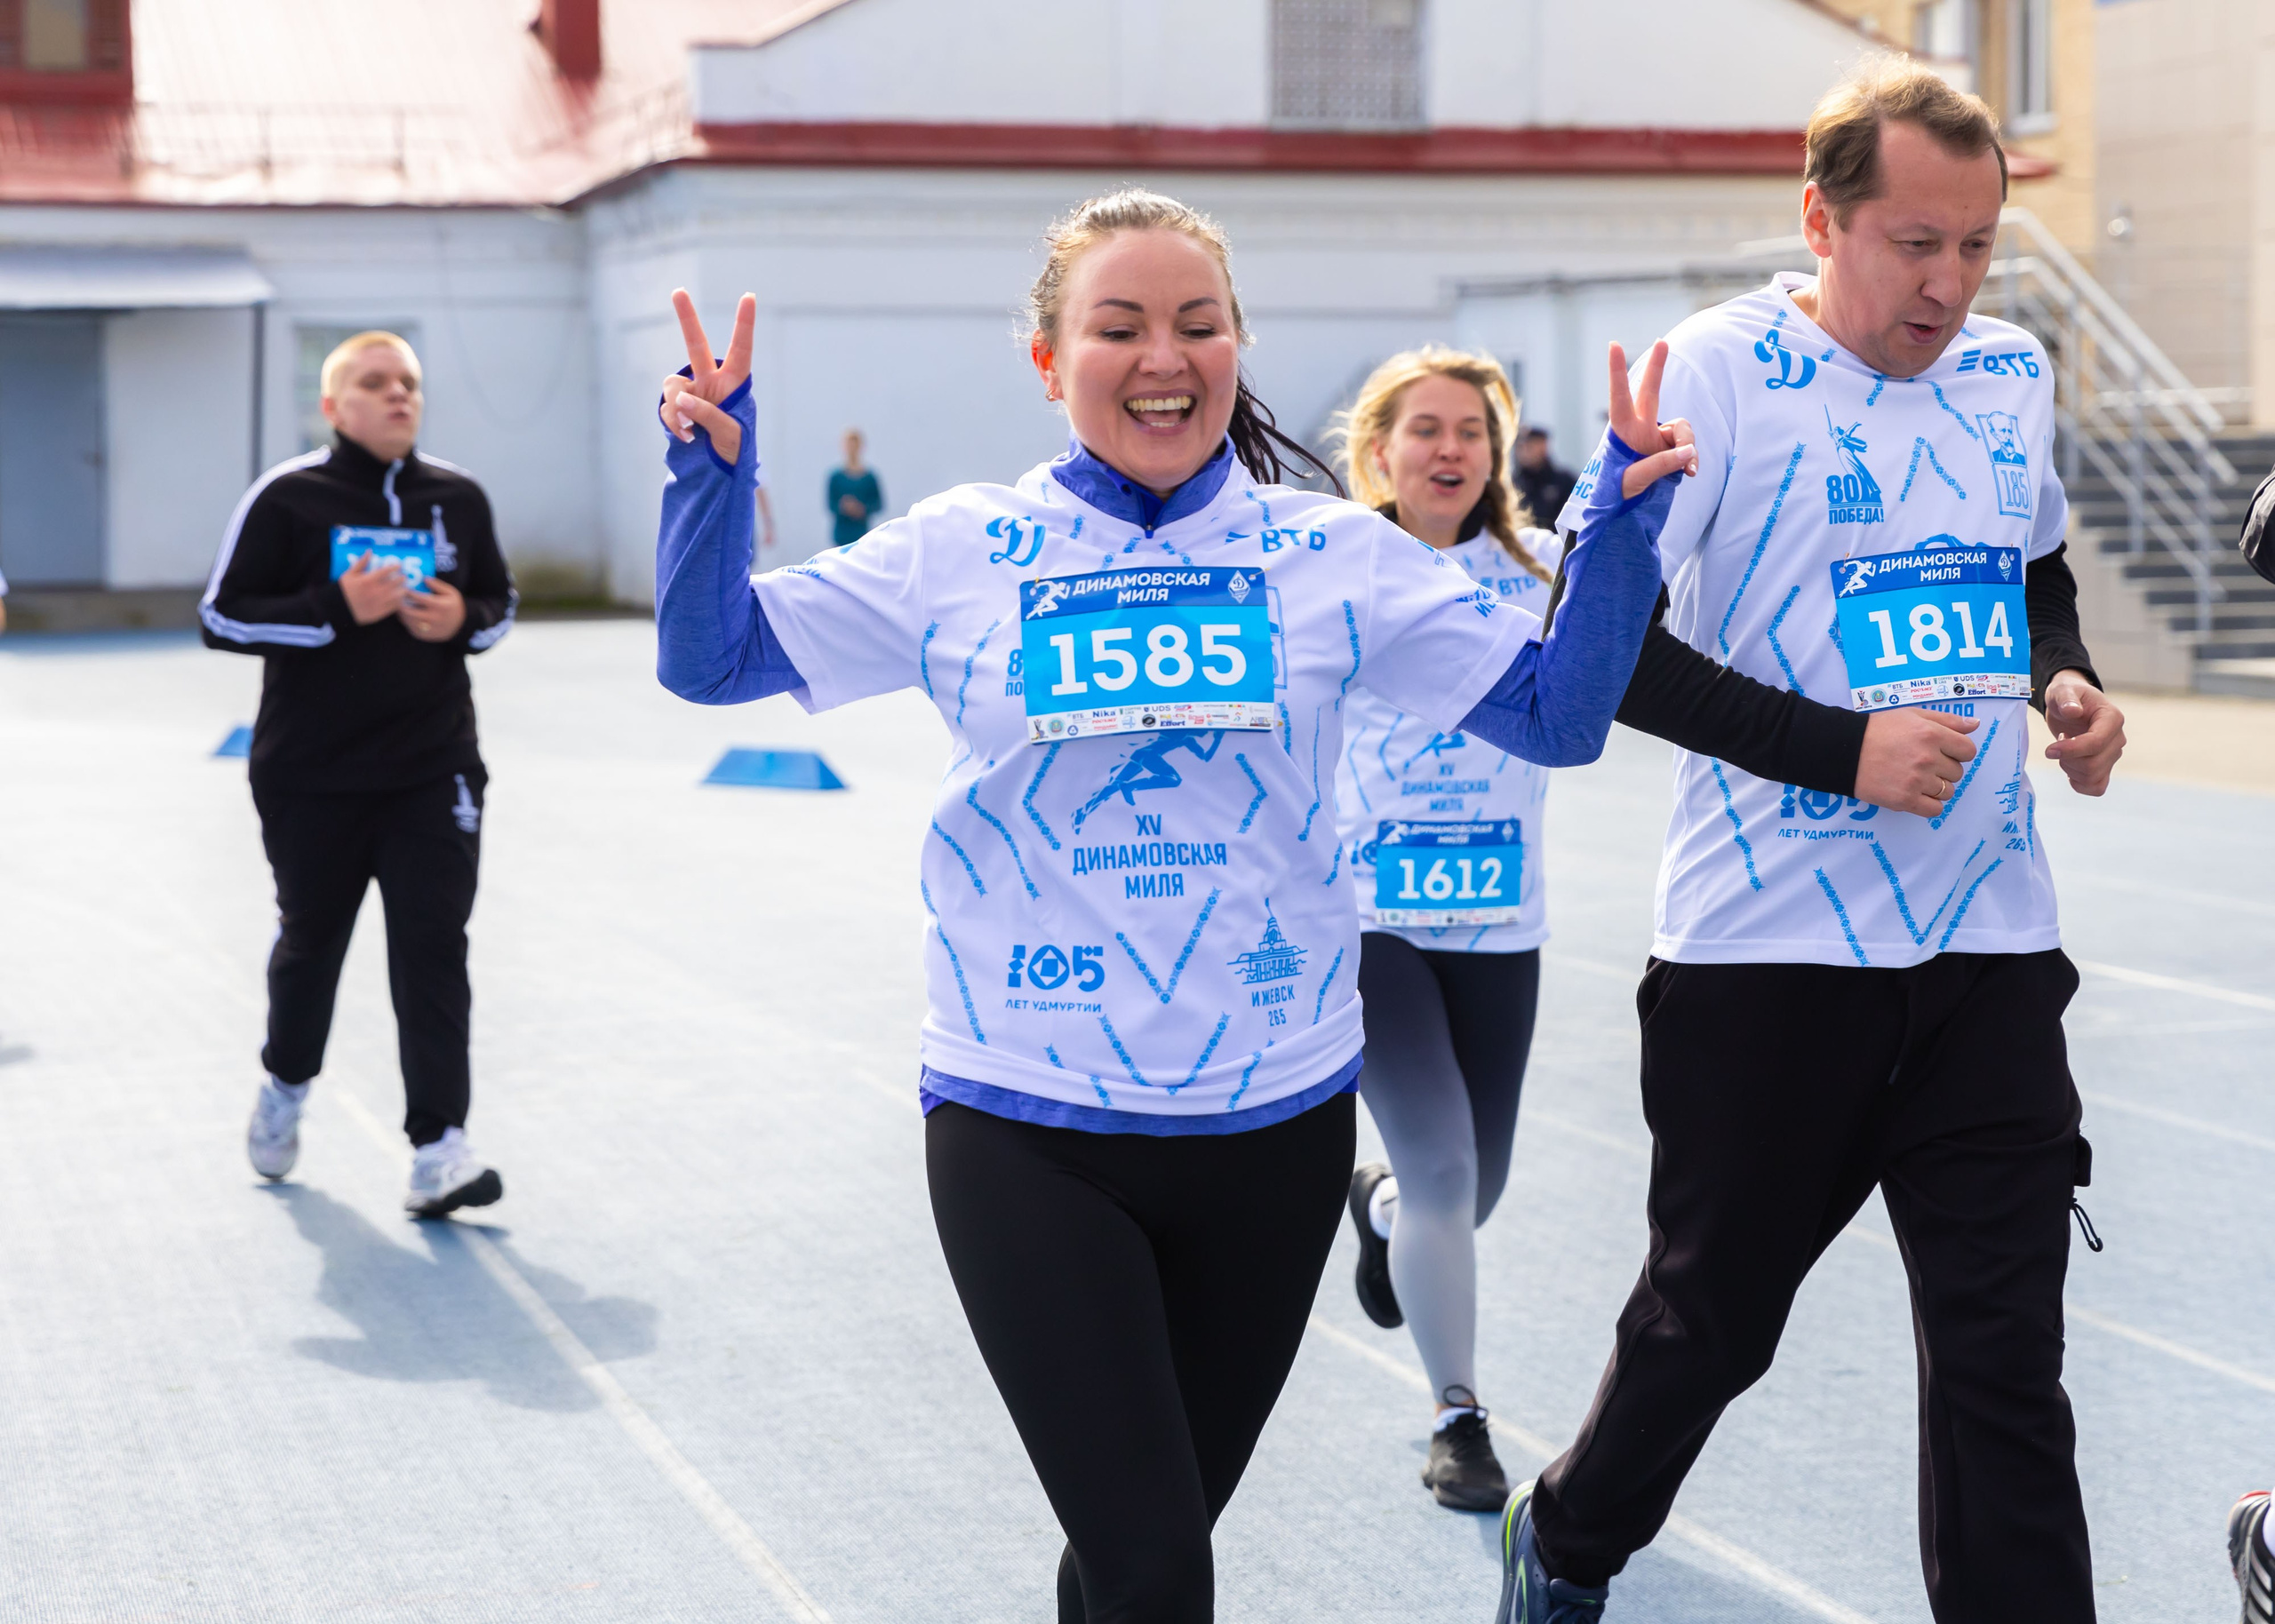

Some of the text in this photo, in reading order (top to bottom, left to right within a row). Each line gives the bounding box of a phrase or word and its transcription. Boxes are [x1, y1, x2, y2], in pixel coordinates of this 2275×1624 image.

[1826, 474, 1860, 504] 80
[2000, 469, 2030, 510] 185
[1828, 507, 1885, 525] ПОБЕДА!
[1879, 552, 1987, 574] ДИНАМОВСКАЯ
[1920, 567, 1961, 582] МИЛЯ
[1072, 572, 1211, 596] ДИНАМОВСКАЯ
[1117, 588, 1169, 604] МИЛЯ
[1868, 601, 2014, 669] 1814
[1050, 624, 1247, 697] 1585
[1135, 814, 1161, 836] XV
[1777, 828, 1874, 840] ЛЕТ УДМУРТИИ
[1073, 842, 1227, 876] ДИНАМОВСКАЯ
[1125, 873, 1184, 899] МИЛЯ
[1398, 857, 1503, 900] 1612
[1008, 944, 1106, 992] 105
[1005, 999, 1102, 1013] ЛЕТ УДМУРТИИ
[1251, 984, 1296, 1007] ИЖЕВСК
[1268, 1008, 1287, 1027] 265
